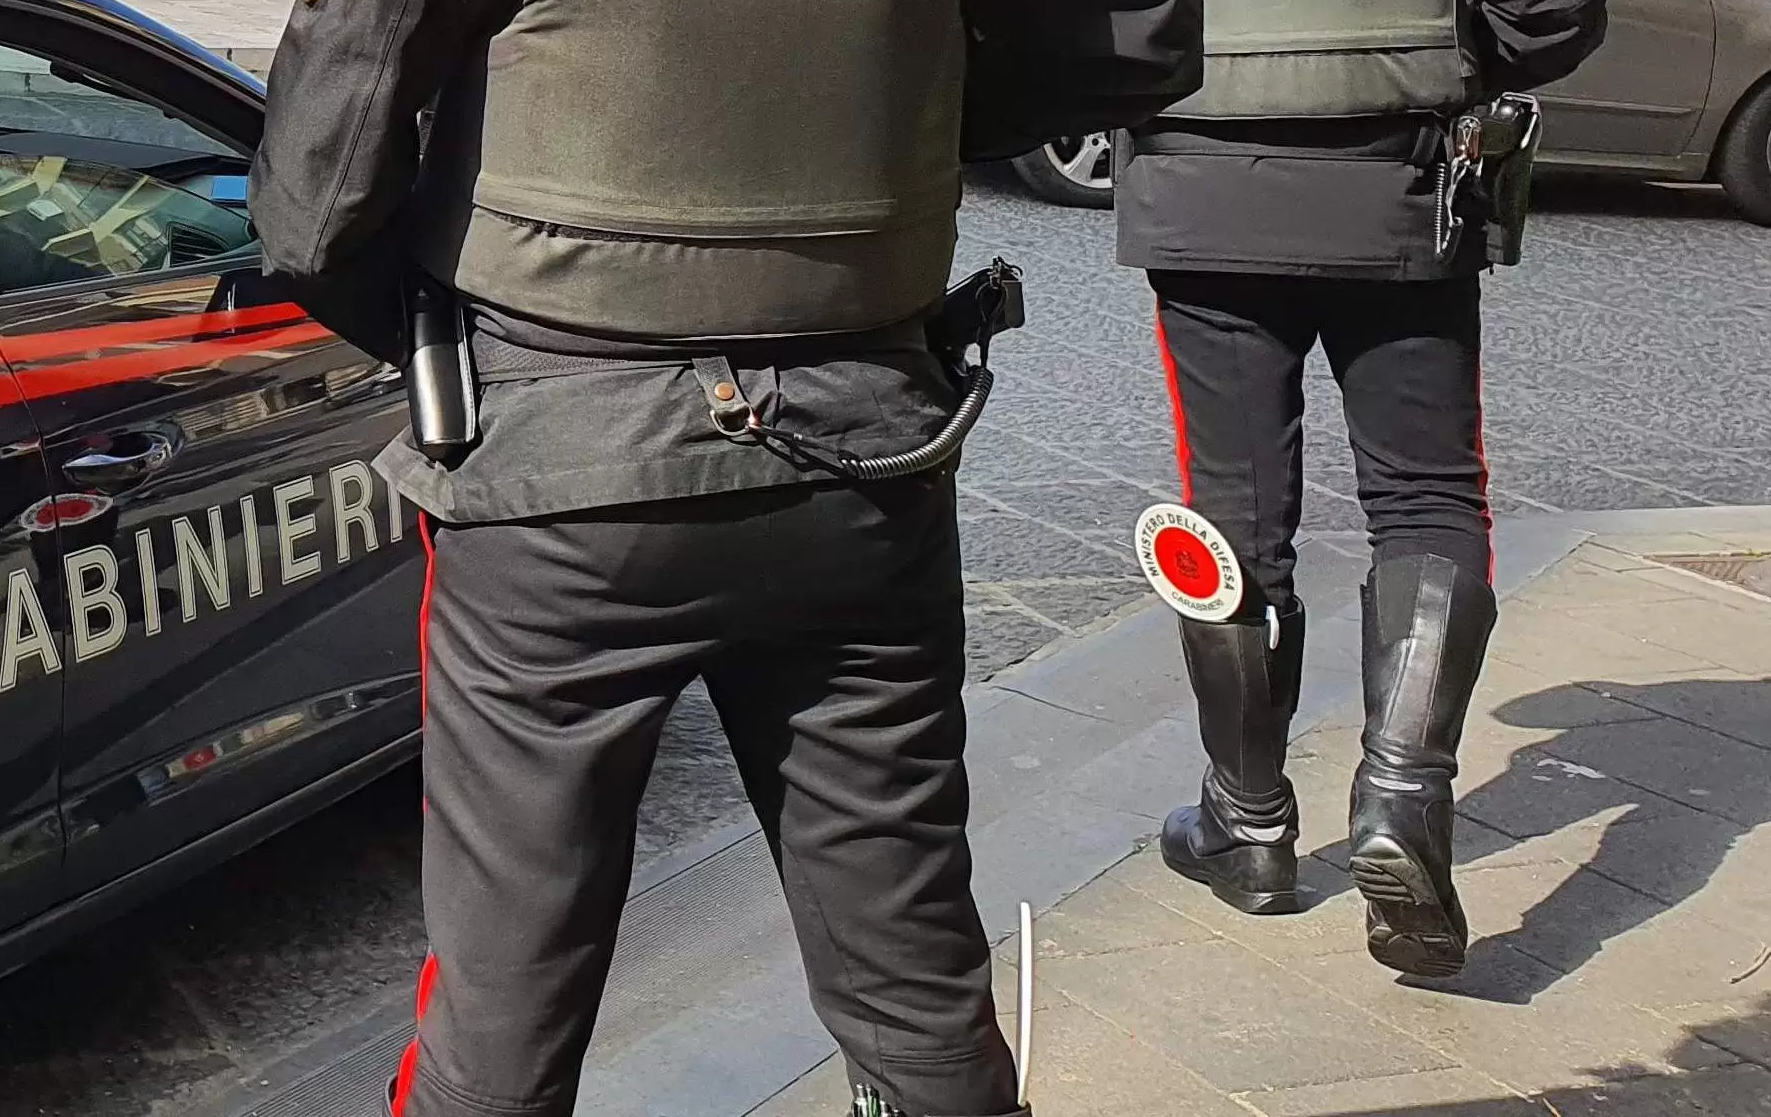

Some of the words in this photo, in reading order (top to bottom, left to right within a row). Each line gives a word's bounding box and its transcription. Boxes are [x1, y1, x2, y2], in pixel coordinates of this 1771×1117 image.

[1141, 514, 1165, 577] MINISTERO
[1167, 513, 1208, 541] DELLA
[1209, 541, 1235, 591] DIFESA
